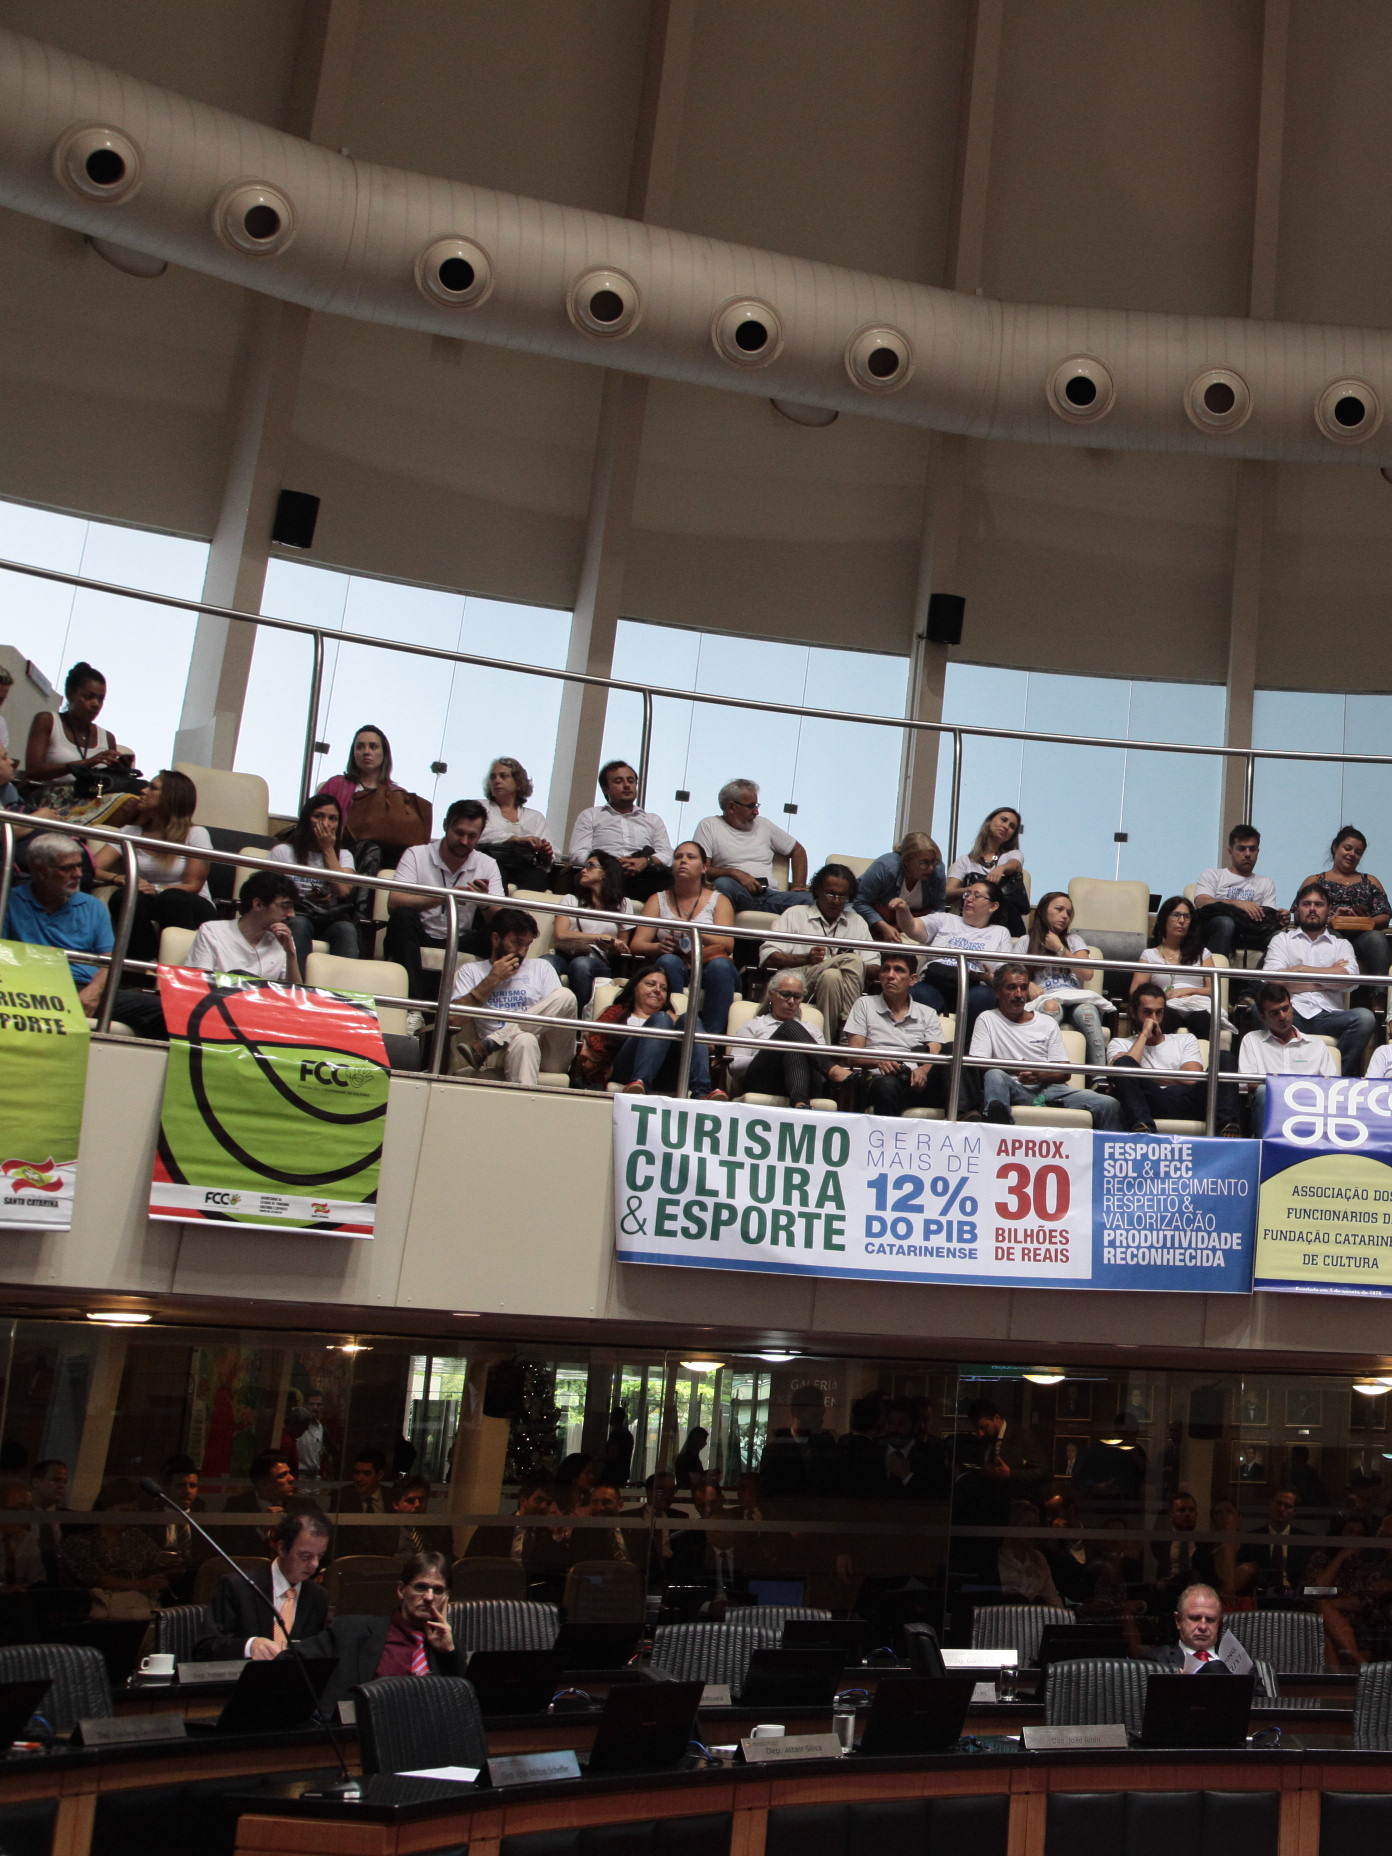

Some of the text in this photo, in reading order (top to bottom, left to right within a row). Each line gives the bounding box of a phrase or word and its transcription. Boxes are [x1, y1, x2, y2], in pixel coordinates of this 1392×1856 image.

[300, 1060, 350, 1087] FCC
[630, 1104, 850, 1168] TURISMO
[868, 1130, 981, 1155] GERAM
[996, 1138, 1070, 1160] APROX.
[1104, 1142, 1192, 1161] FESPORTE
[867, 1153, 980, 1174] MAIS DE
[1103, 1160, 1193, 1178] SOL & FCC
[625, 1149, 846, 1212] CULTURA
[1103, 1178, 1248, 1197] RECONHECIMENTO
[205, 1192, 230, 1205] FCC
[866, 1173, 979, 1217] 12%
[994, 1163, 1071, 1222] 30
[1291, 1185, 1369, 1202] ASSOCIAÇÃO
[1103, 1195, 1194, 1212] RESPEITO &
[654, 1198, 847, 1252] ESPORTE
[1103, 1210, 1216, 1231] VALORIZAÇÃO
[1286, 1207, 1378, 1224] FUNCIONÁRIOS
[865, 1218, 978, 1244] DO PIB
[994, 1224, 1070, 1246] BILHÕES
[1103, 1229, 1242, 1250] PRODUTIVIDADE
[1263, 1228, 1330, 1246] FUNDAÇÃO
[864, 1242, 978, 1260] CATARINENSE
[994, 1246, 1070, 1263] DE REAIS
[1103, 1248, 1225, 1268] RECONHECIDA
[1302, 1254, 1379, 1269] DE CULTURA
[766, 1747, 782, 1756] Dep.
